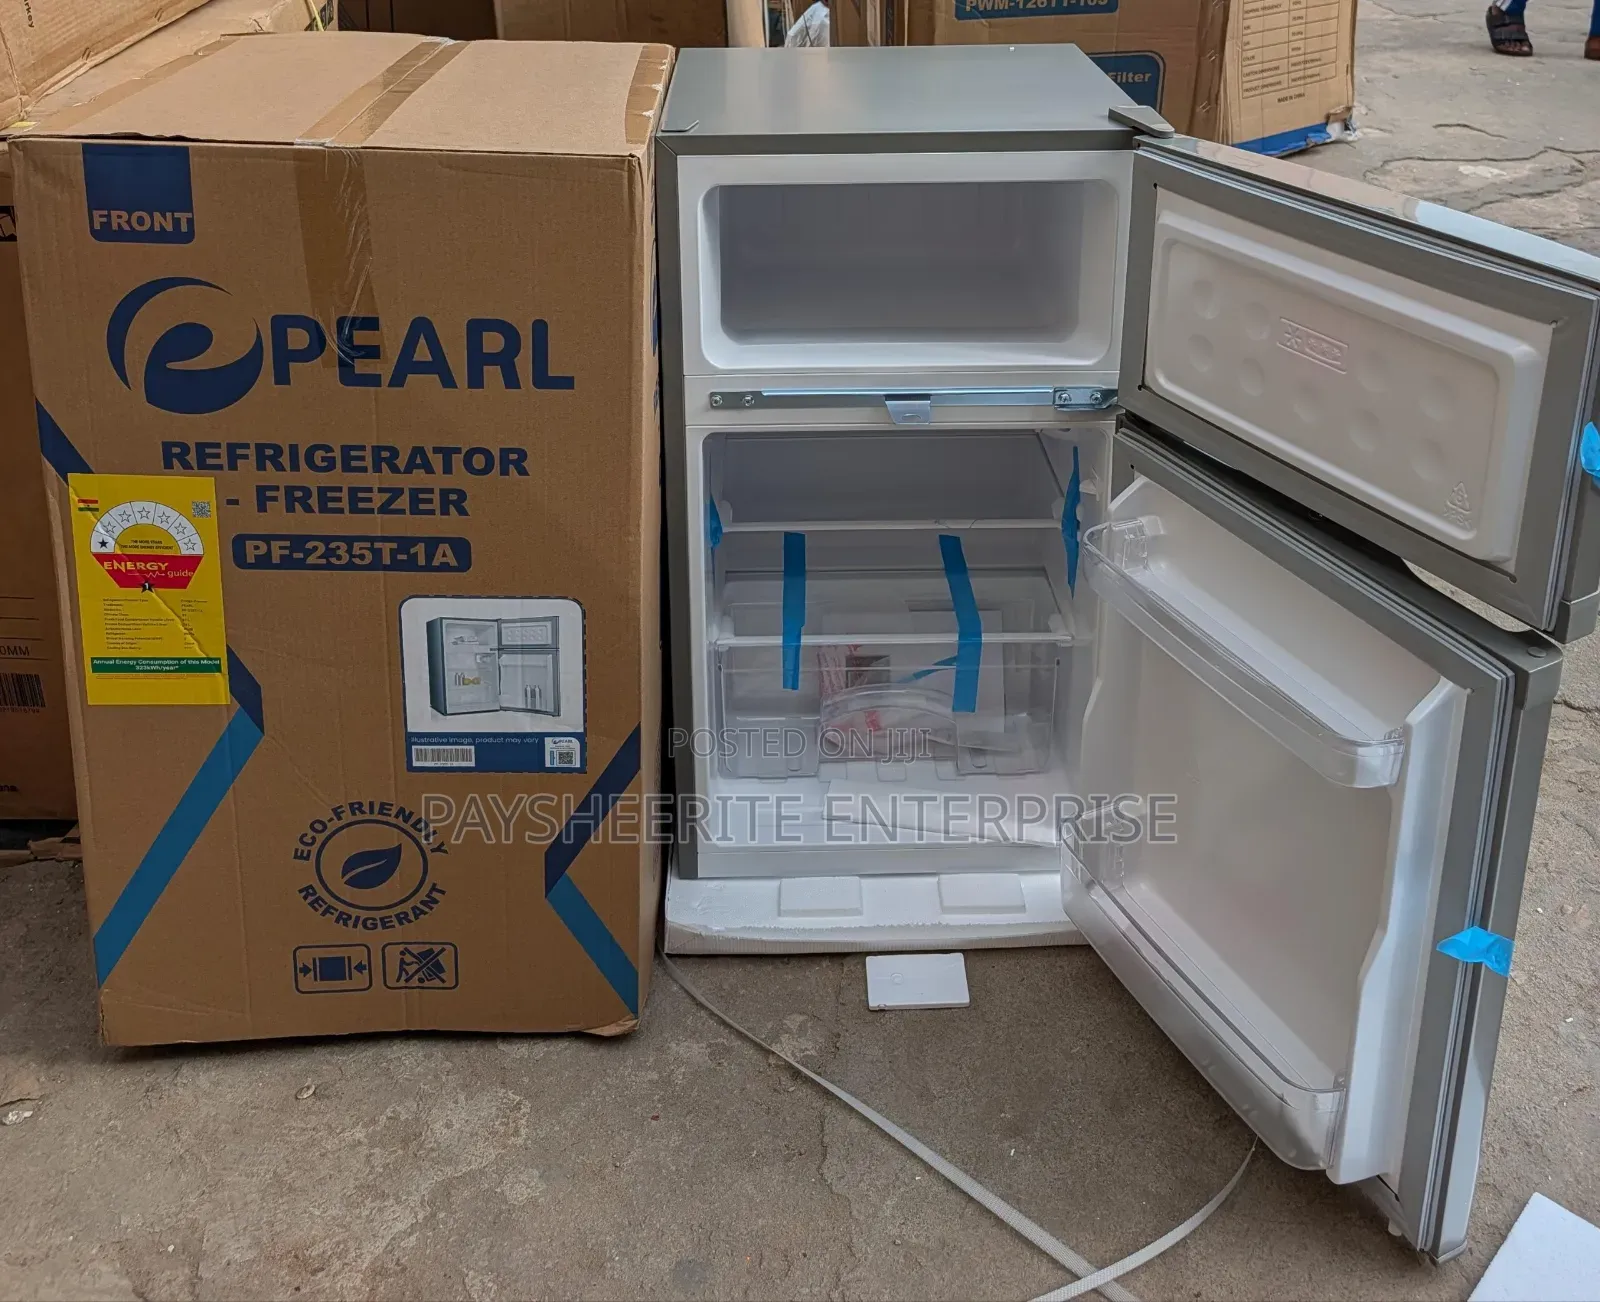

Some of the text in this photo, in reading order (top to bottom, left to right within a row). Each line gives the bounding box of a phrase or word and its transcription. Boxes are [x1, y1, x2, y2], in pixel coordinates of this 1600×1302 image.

[1277, 95, 1289, 103] MADE
[92, 209, 193, 234] FRONT
[270, 314, 575, 390] PEARL
[160, 440, 531, 477] REFRIGERATOR
[254, 484, 471, 517] FREEZER
[103, 560, 169, 573] ENERGY
[244, 540, 459, 568] PF-235T-1A
[167, 569, 194, 578] guide
[293, 800, 449, 862] ECO-FRIENDLY
[297, 882, 447, 931] REFRIGERANT
